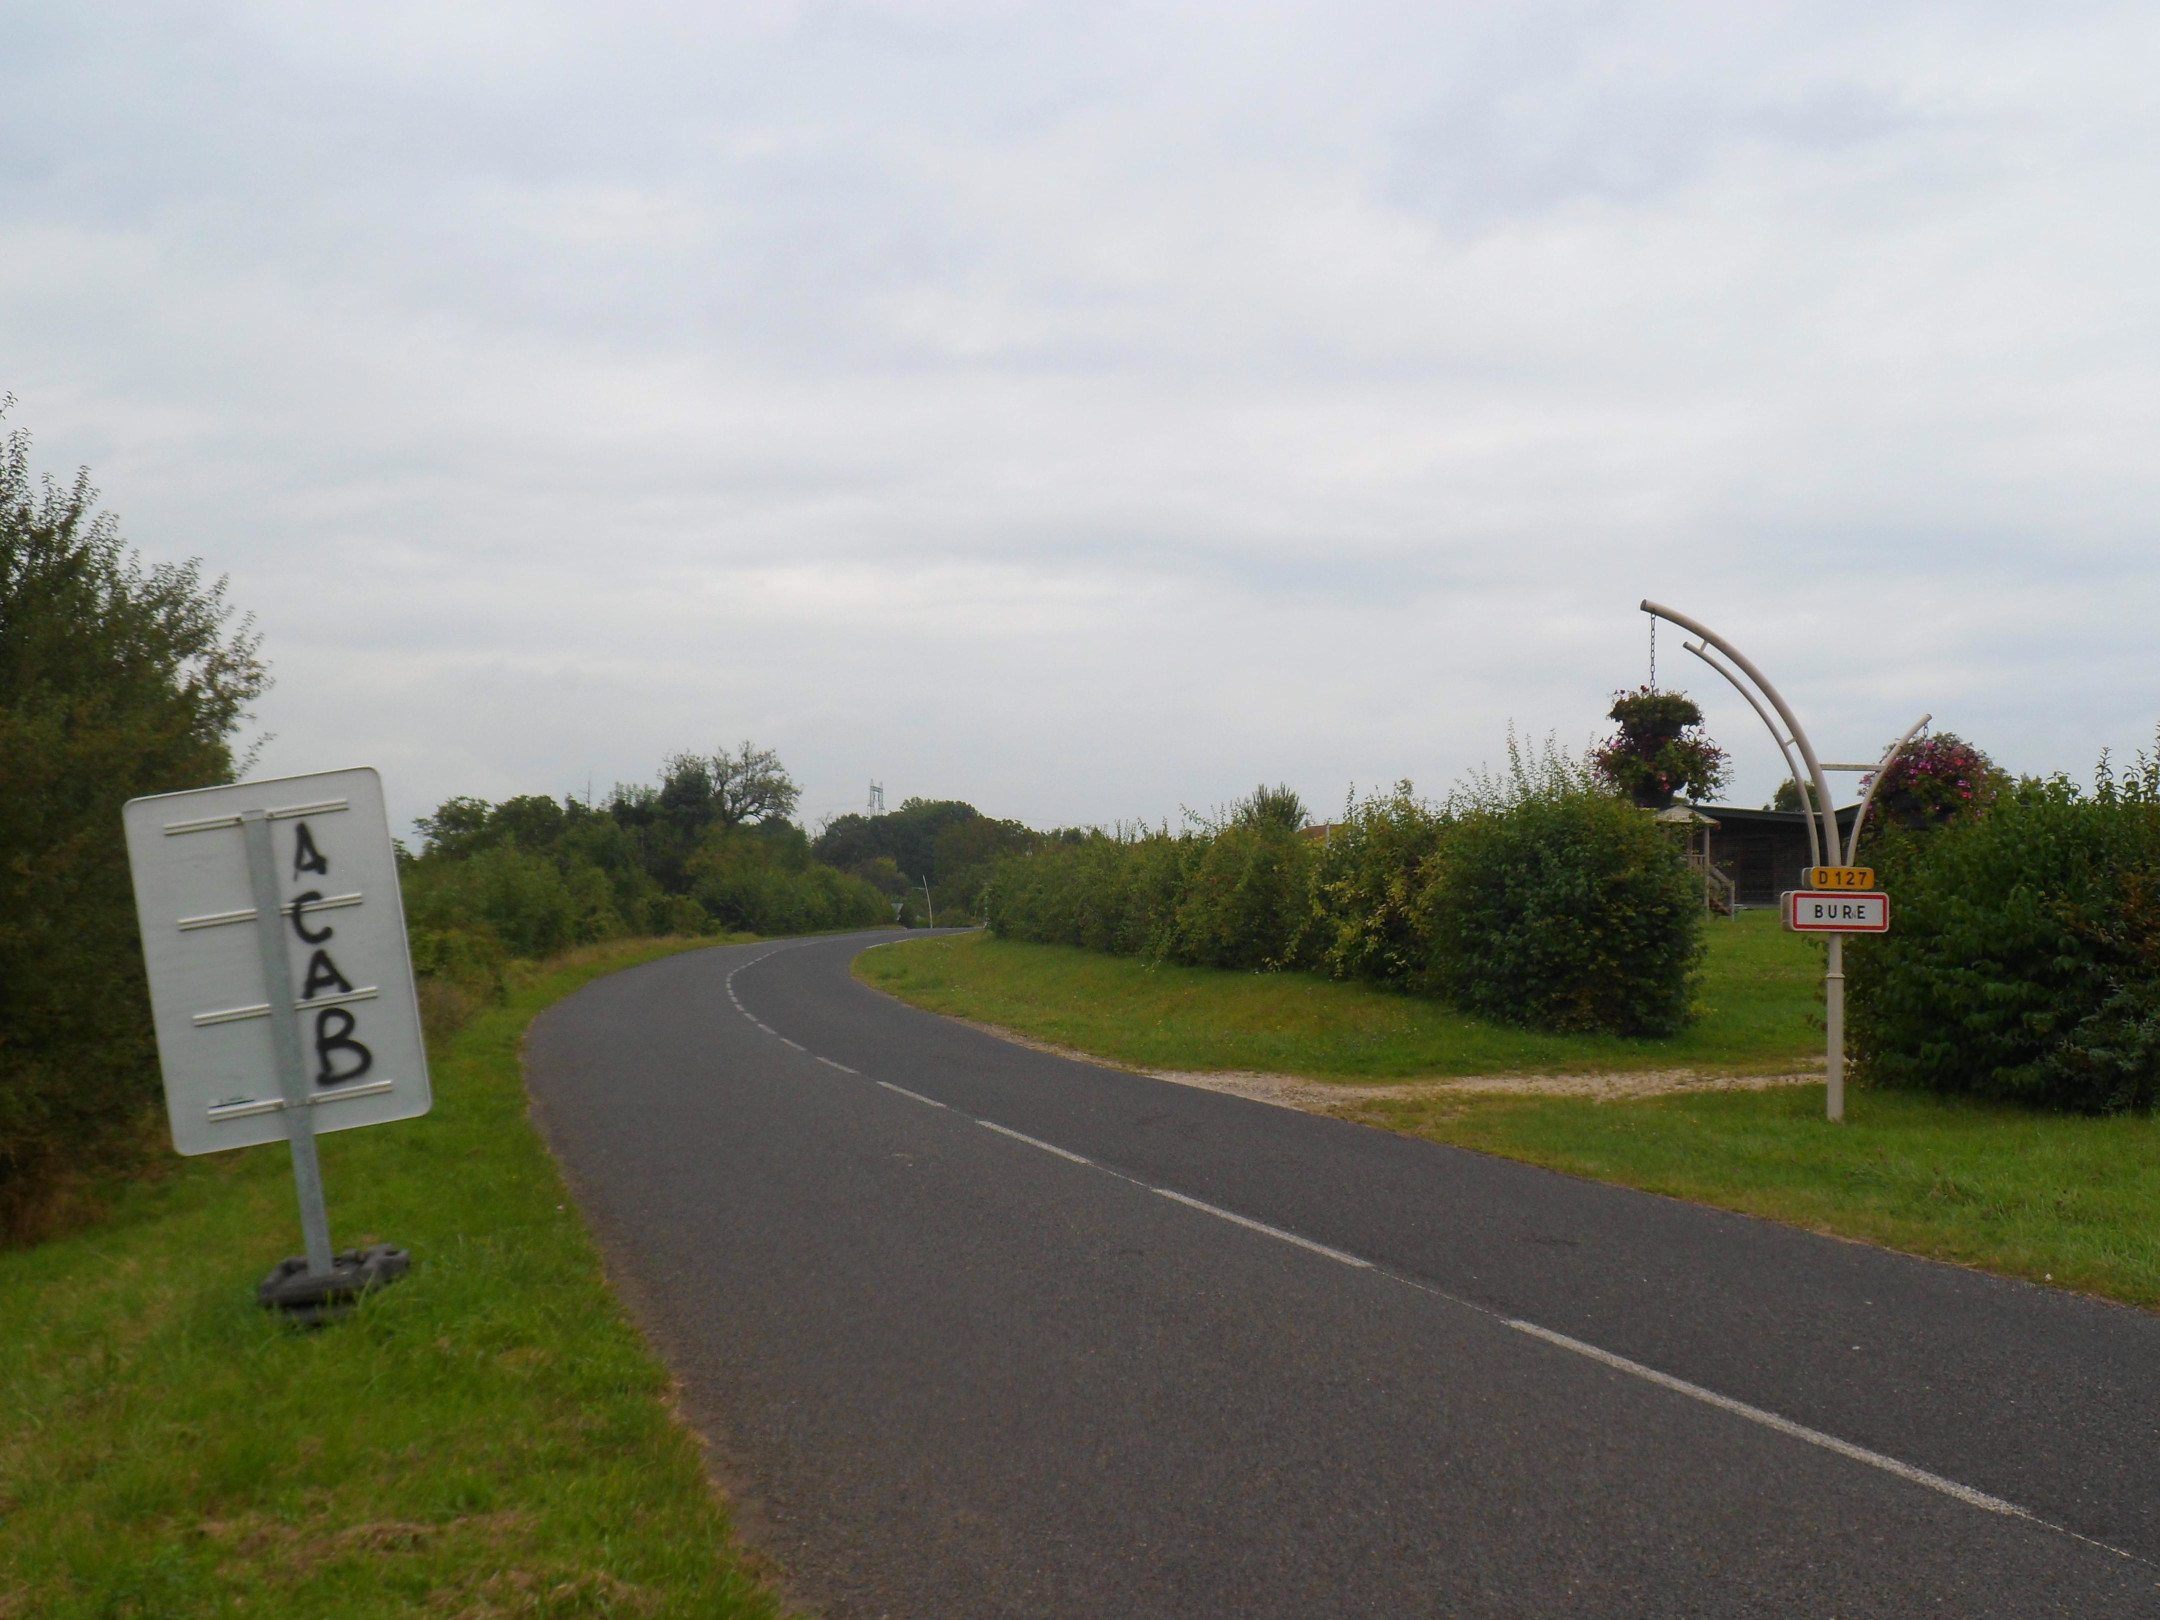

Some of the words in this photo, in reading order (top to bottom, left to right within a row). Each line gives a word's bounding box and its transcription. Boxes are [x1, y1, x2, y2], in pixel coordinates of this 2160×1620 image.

[1818, 871, 1828, 884] D
[1835, 872, 1867, 885] 127
[1814, 904, 1866, 919] BURE
[290, 822, 372, 1085] ACAB
